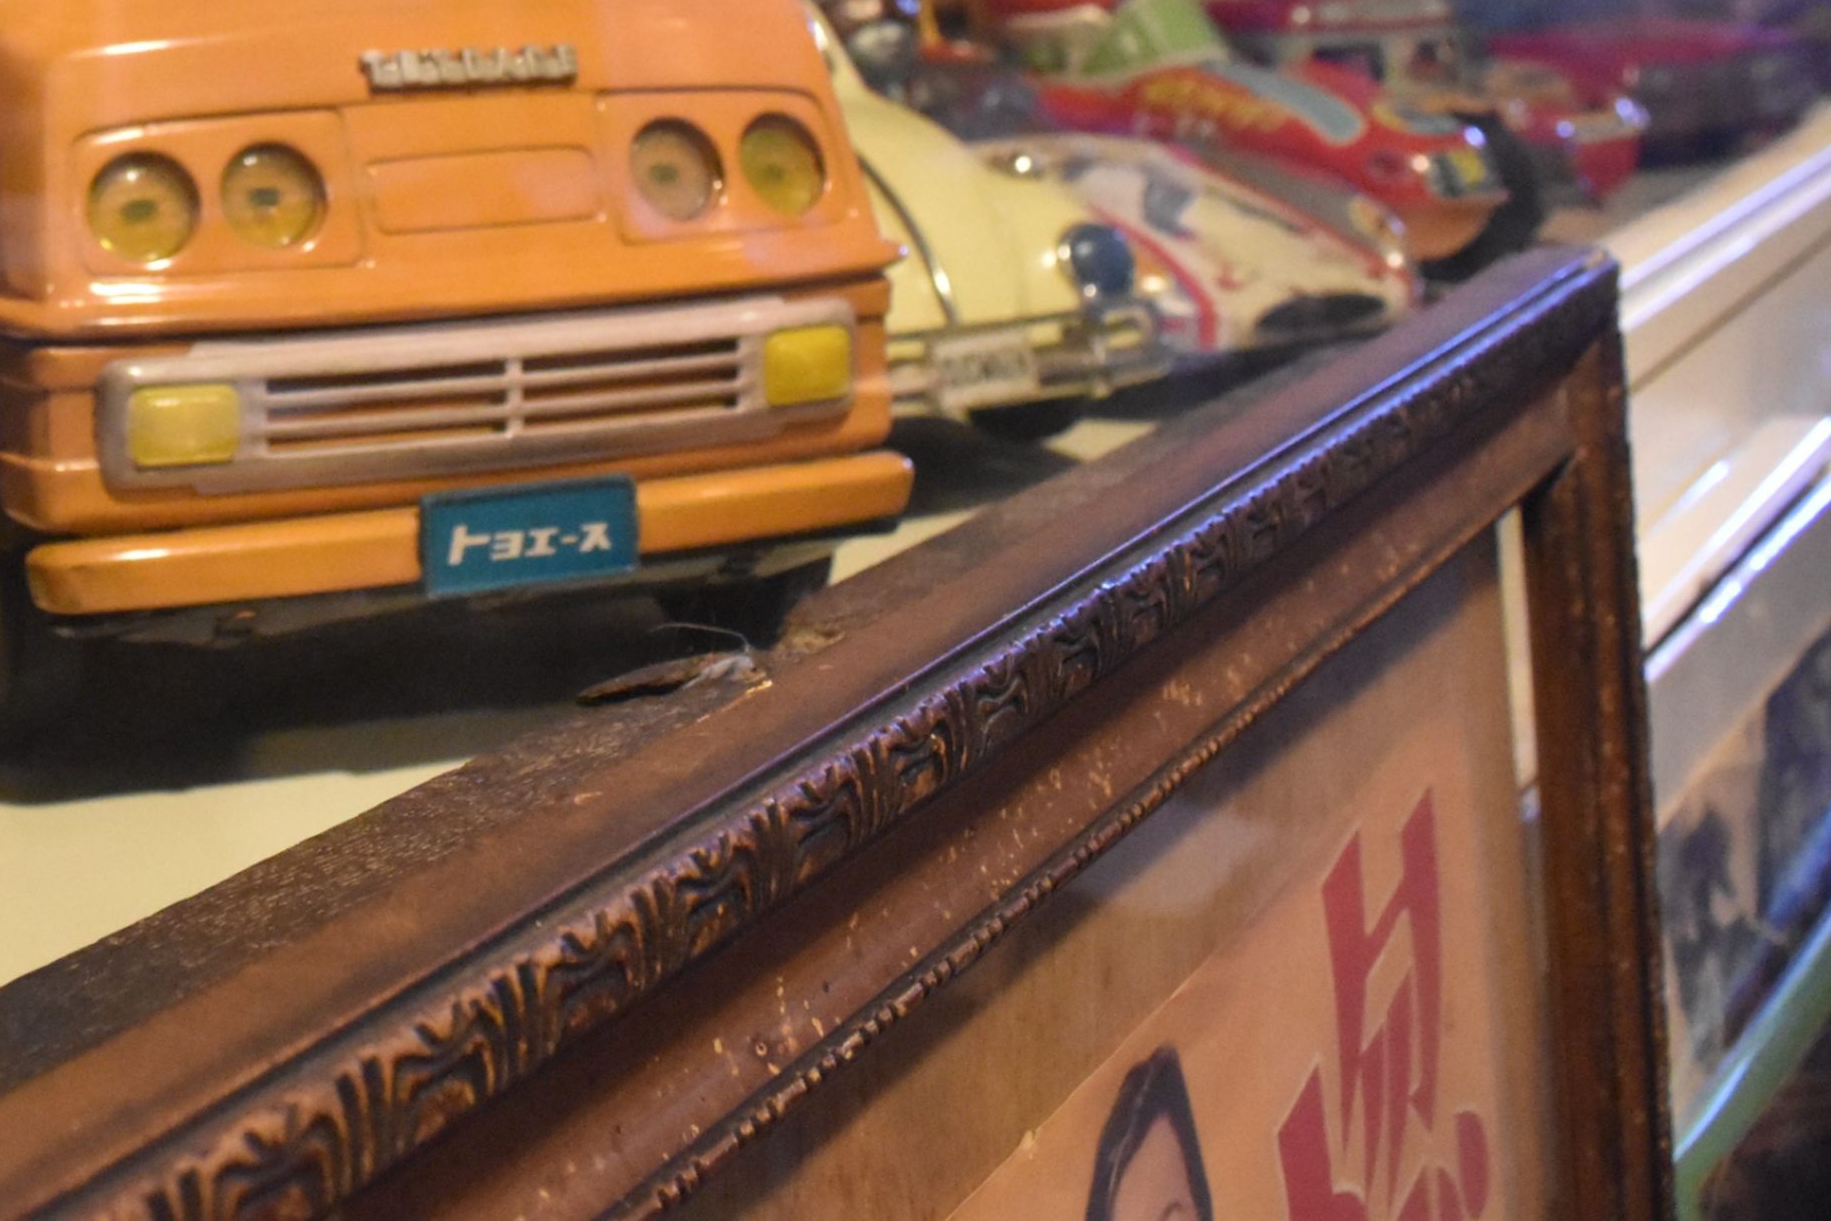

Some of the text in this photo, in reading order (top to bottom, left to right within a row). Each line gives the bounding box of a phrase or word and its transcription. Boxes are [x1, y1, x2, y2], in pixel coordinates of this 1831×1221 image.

[447, 522, 612, 566] トヨエース
